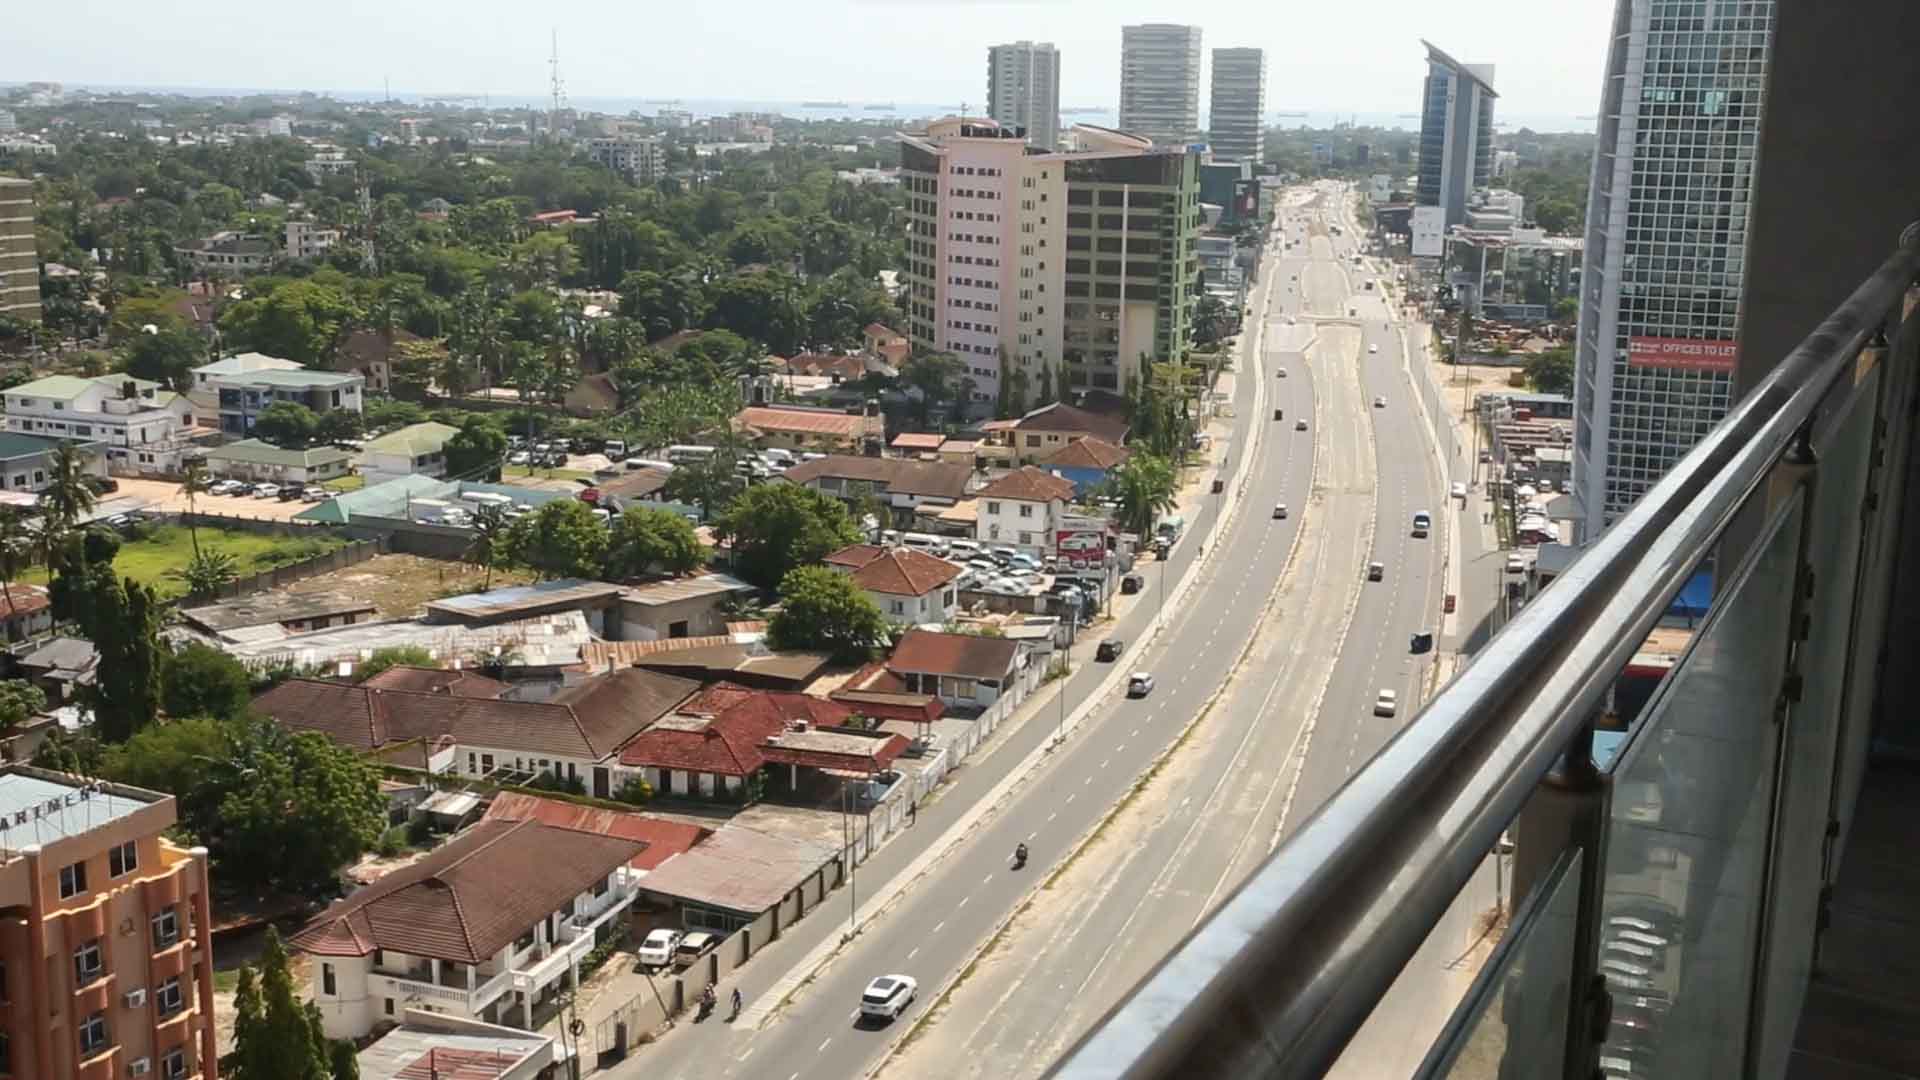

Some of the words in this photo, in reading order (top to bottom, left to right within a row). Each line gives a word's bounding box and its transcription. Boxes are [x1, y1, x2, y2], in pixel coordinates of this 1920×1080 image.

[1663, 343, 1703, 355] OFFICES
[1704, 345, 1718, 356] TO
[1719, 346, 1737, 357] LET
